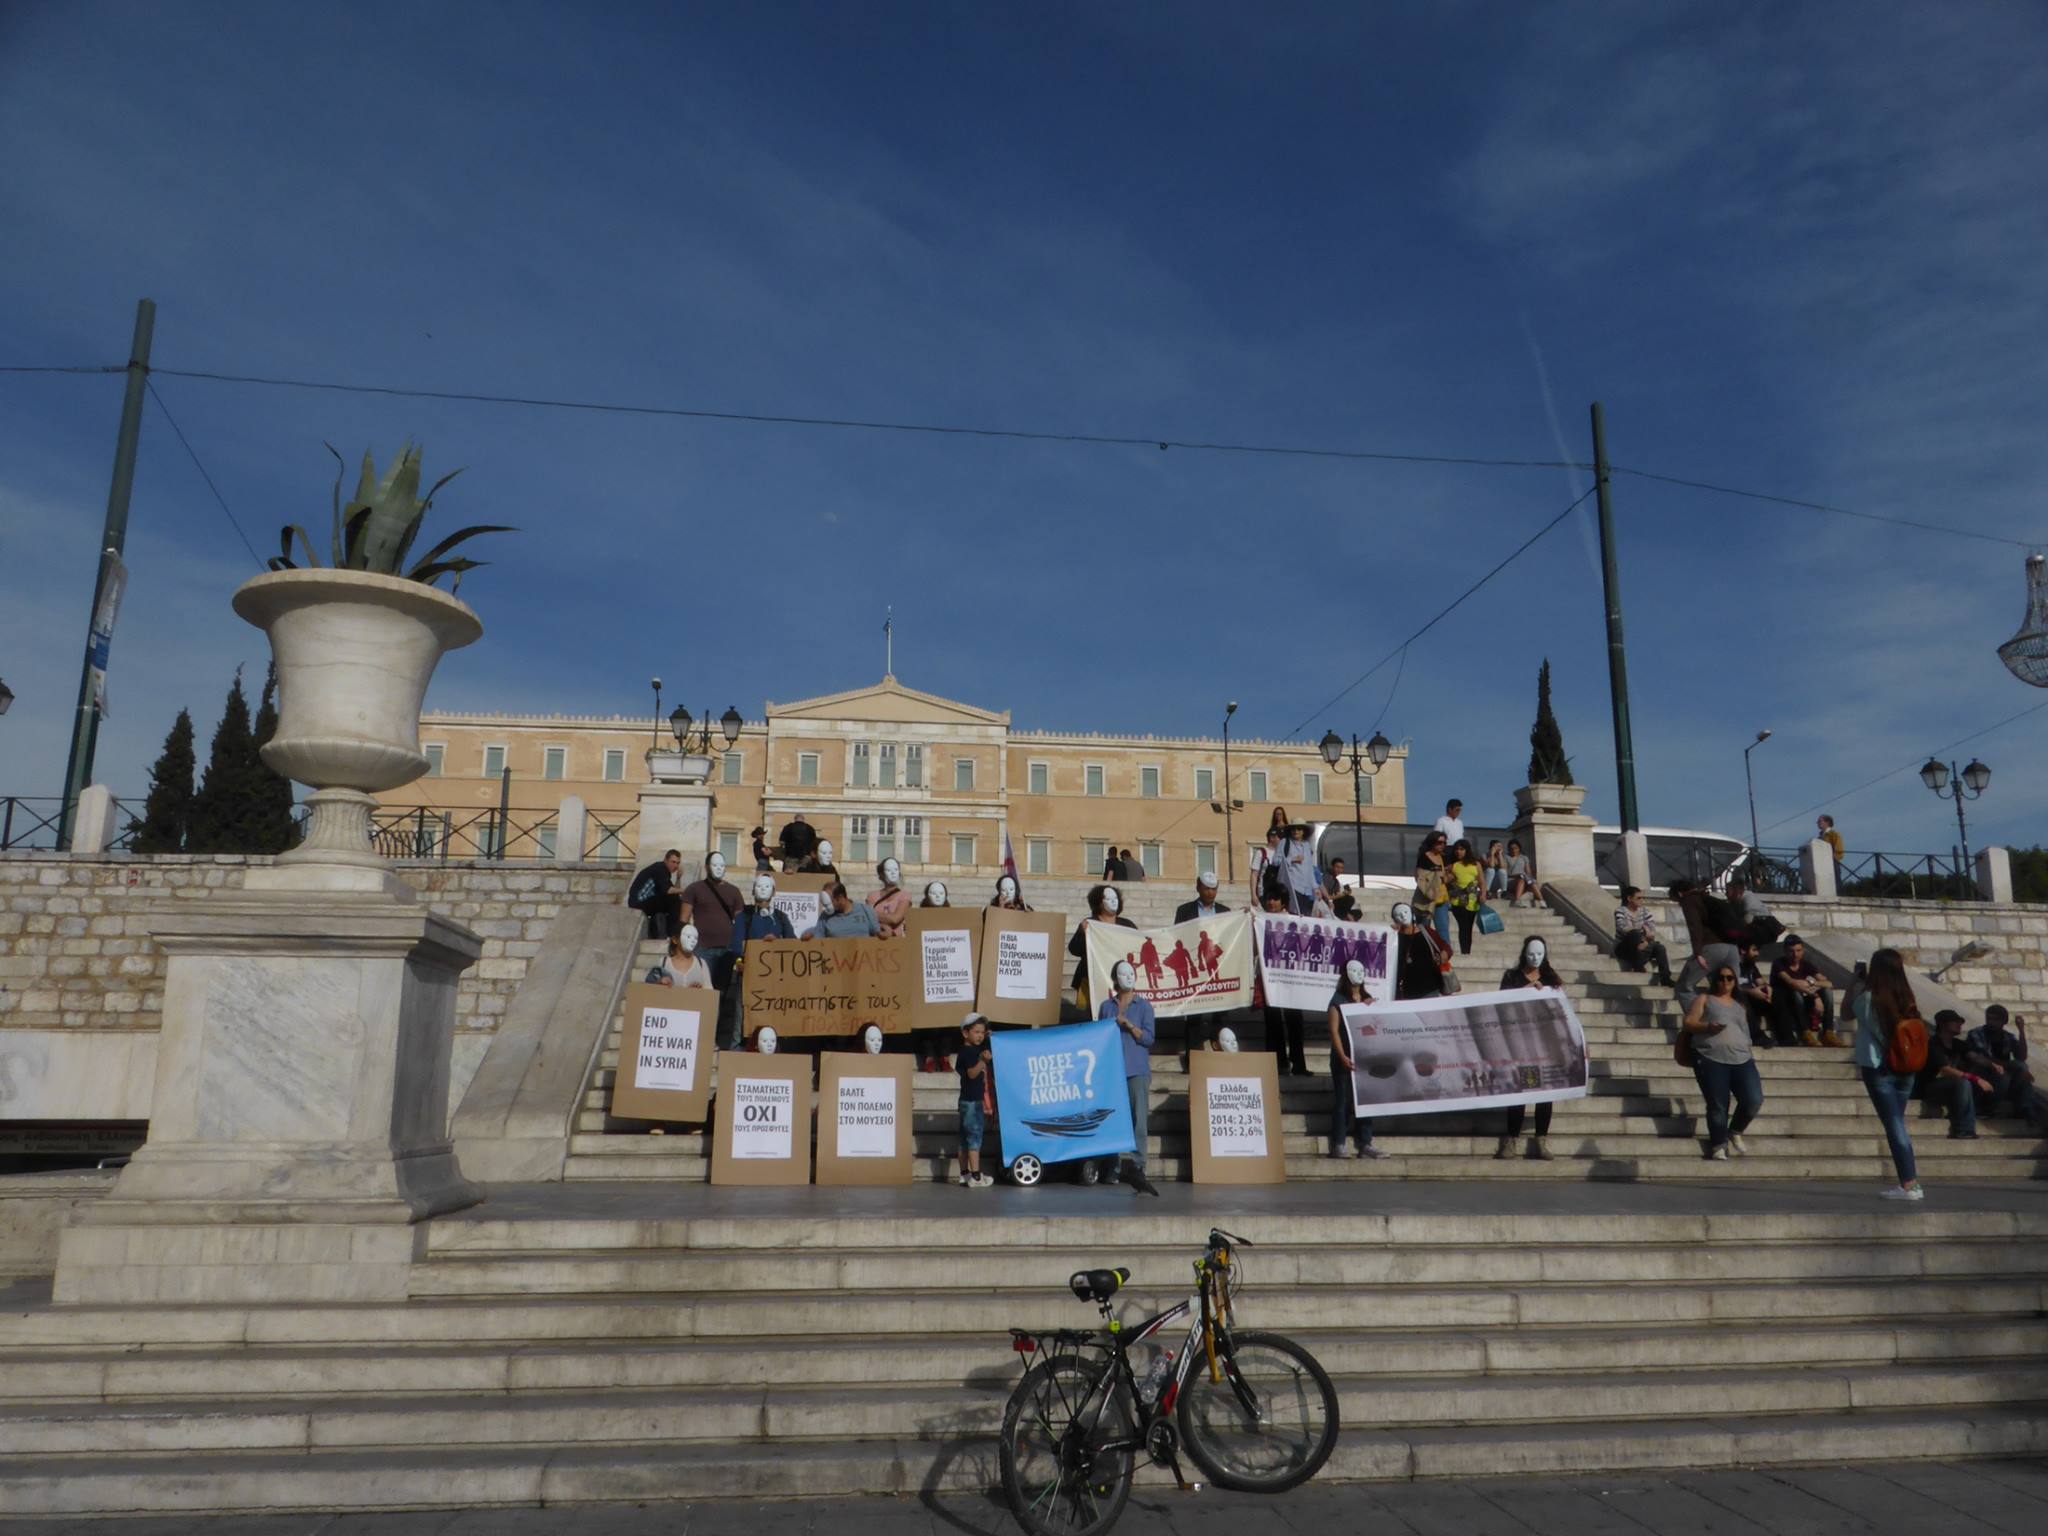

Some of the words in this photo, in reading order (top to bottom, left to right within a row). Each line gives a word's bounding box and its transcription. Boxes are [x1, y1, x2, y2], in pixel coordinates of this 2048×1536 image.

[795, 902, 817, 913] 36%
[925, 946, 956, 956] Γερμανία
[1000, 942, 1017, 950] ΕΙΝΑΙ
[1000, 951, 1008, 959] ΤΟ
[1008, 951, 1047, 960] ΠΡΟΒΛΗΜΑ
[758, 949, 823, 978] STOP
[832, 948, 901, 974] WARS
[1000, 959, 1010, 967] ΚΑΙ
[936, 969, 969, 979] Βρετανία
[1004, 968, 1022, 976] ΛΥΣΗ
[1156, 986, 1194, 999] ΦΟΡΟΥΜ
[644, 1015, 668, 1029] END
[642, 1035, 664, 1048] THE
[666, 1036, 693, 1050] WAR
[639, 1055, 653, 1068] IN
[654, 1056, 688, 1070] SYRIA
[1027, 1052, 1074, 1073] ΠΟΣΕΣ
[1030, 1070, 1067, 1088] ΖΩΕΣ
[736, 1084, 790, 1095] ΣΤΑΜΑΤΗΣΤΕ
[840, 1087, 865, 1097] ΒΑΛΤΕ
[1030, 1084, 1081, 1105] ΑΚΟΜΑ
[737, 1094, 753, 1103] ΤΟΥΣ
[754, 1095, 790, 1103] ΠΟΛΕΜΟΥΣ
[840, 1102, 856, 1111] ΤΟΝ
[857, 1102, 893, 1111] ΠΟΛΕΜΟ
[743, 1104, 777, 1122] ΟΧΙ
[839, 1116, 855, 1125] ΣΤΟ
[856, 1116, 894, 1125] ΜΟΥΣΕΙΟ
[1211, 1114, 1237, 1125] 2014:
[1238, 1114, 1262, 1125] 2,3%
[751, 1125, 789, 1133] ΠΡΟΣΦΥΓΕΣ
[1212, 1126, 1238, 1137] 2015:
[1239, 1126, 1263, 1137] 2,6%
